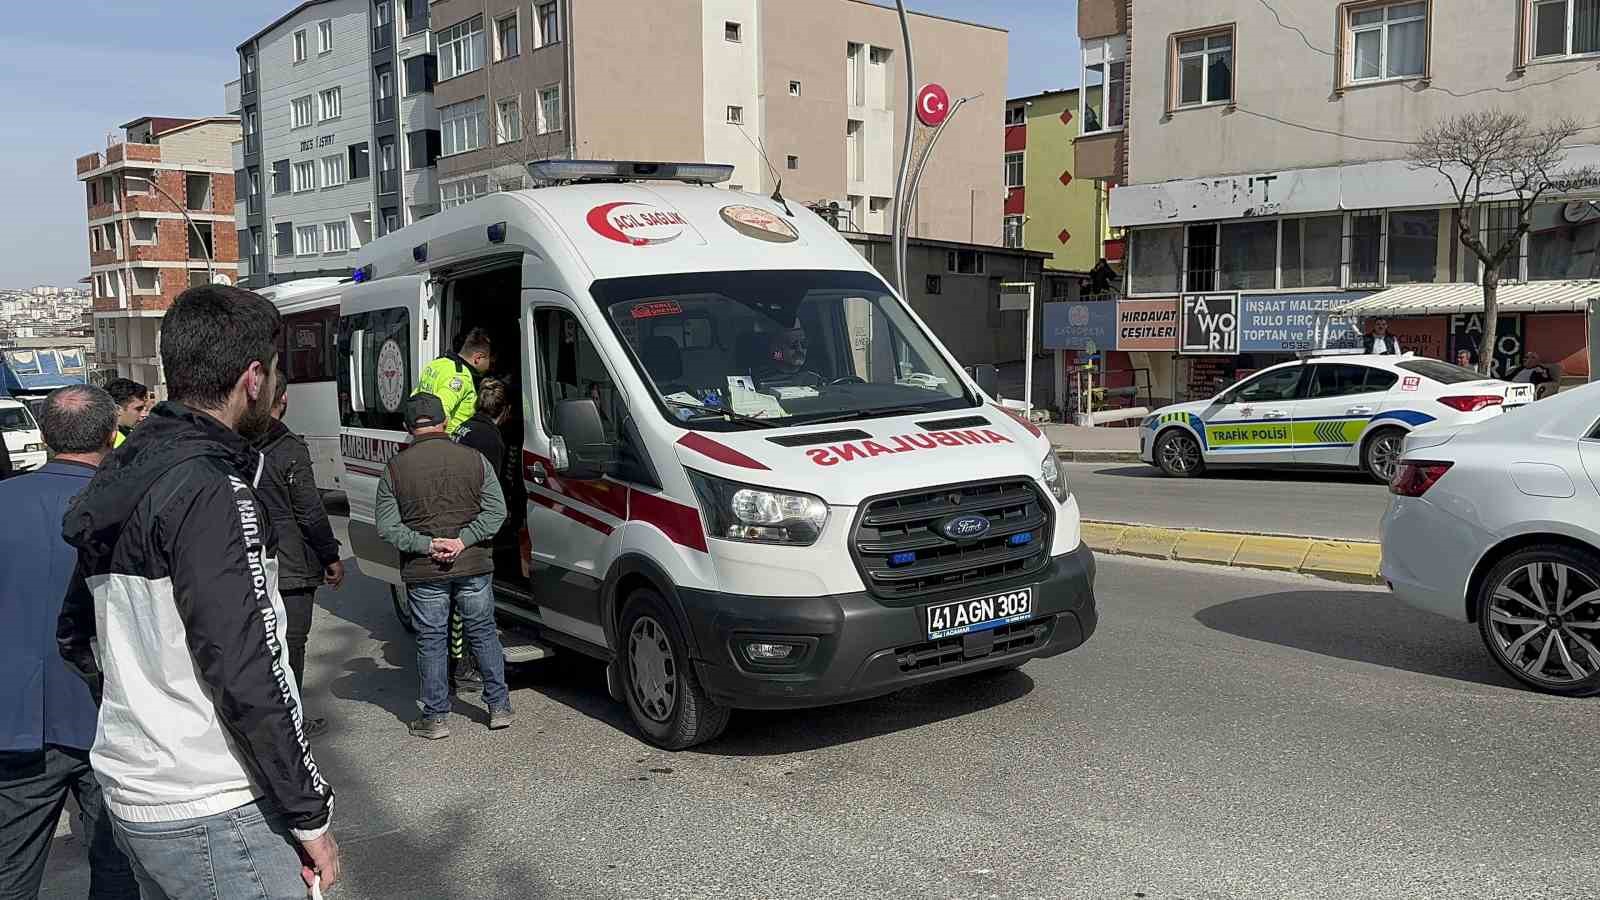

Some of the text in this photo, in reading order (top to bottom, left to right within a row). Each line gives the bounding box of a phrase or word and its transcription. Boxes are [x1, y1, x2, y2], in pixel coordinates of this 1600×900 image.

[1121, 310, 1177, 322] HIRDAVAT
[1246, 299, 1287, 313] İNŞAAT
[1252, 315, 1283, 326] RULO
[1243, 329, 1287, 341] TOPTAN
[1290, 332, 1304, 340] ve
[1212, 426, 1287, 442] TRAFİK POLİSİ
[236, 499, 261, 549] TURN
[958, 519, 982, 535] Ford
[247, 550, 266, 600] YOUR
[932, 591, 1028, 630] 41 AGN 303
[261, 606, 281, 656] TURN
[271, 657, 291, 703] YOUR
[290, 706, 309, 753] TURN
[303, 755, 325, 796] YOUR
